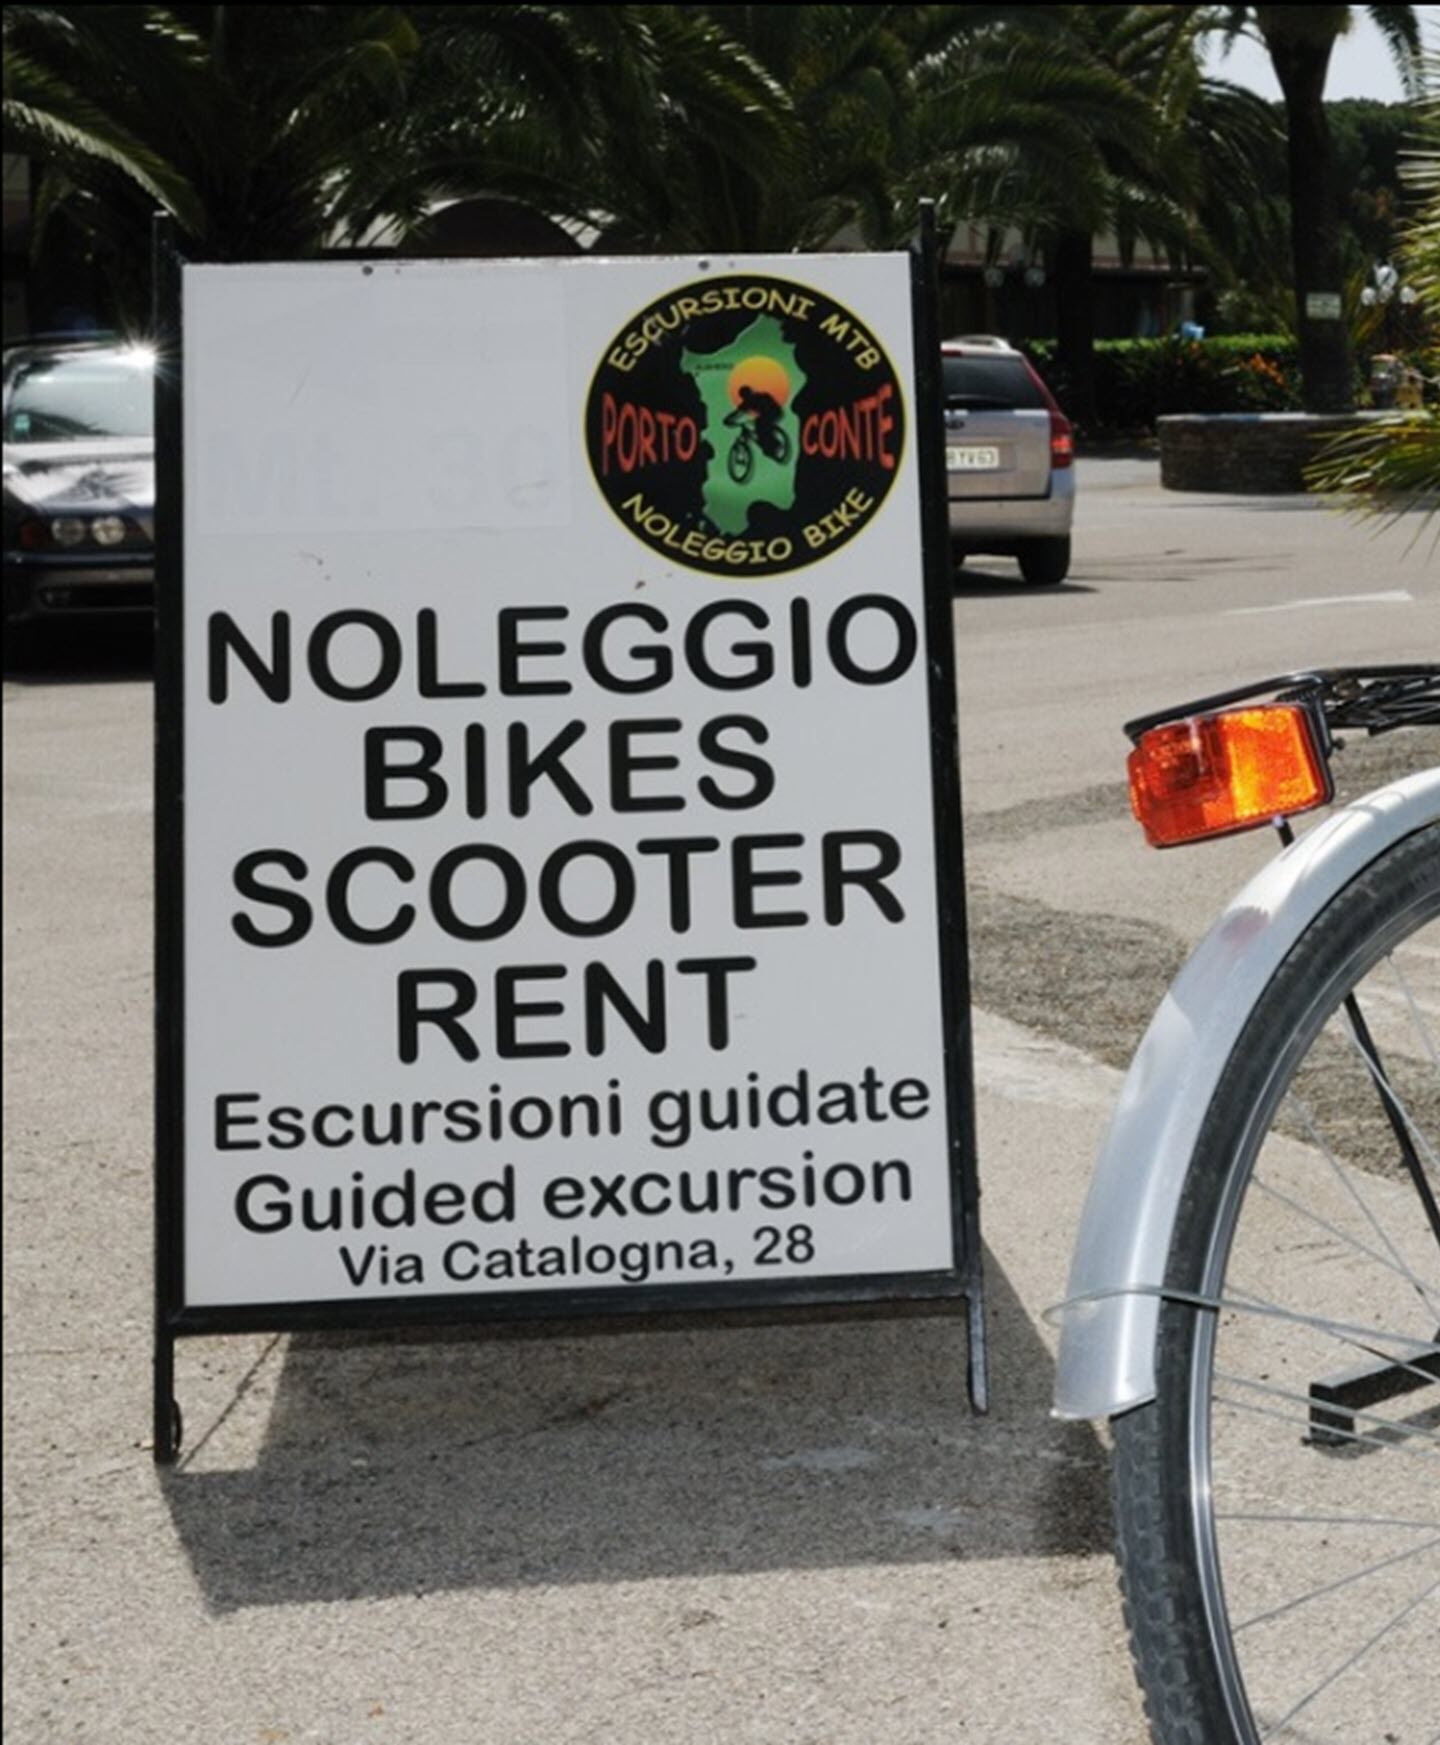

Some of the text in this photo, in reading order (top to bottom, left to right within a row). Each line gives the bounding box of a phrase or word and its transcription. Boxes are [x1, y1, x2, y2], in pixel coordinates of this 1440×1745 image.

[608, 286, 881, 372] ESCURSIONI MTB
[602, 391, 697, 477] PORTO
[802, 383, 895, 470] CONTE
[621, 486, 875, 565] NOLEGGIO BIKE
[207, 593, 918, 705] NOLEGGIO
[363, 714, 775, 822] BIKES
[231, 829, 905, 949] SCOOTER
[397, 955, 757, 1065] RENT
[213, 1066, 930, 1152] Escursioni guidate
[234, 1150, 912, 1234] Guided excursion
[339, 1223, 816, 1287] Via Catalogna, 28
